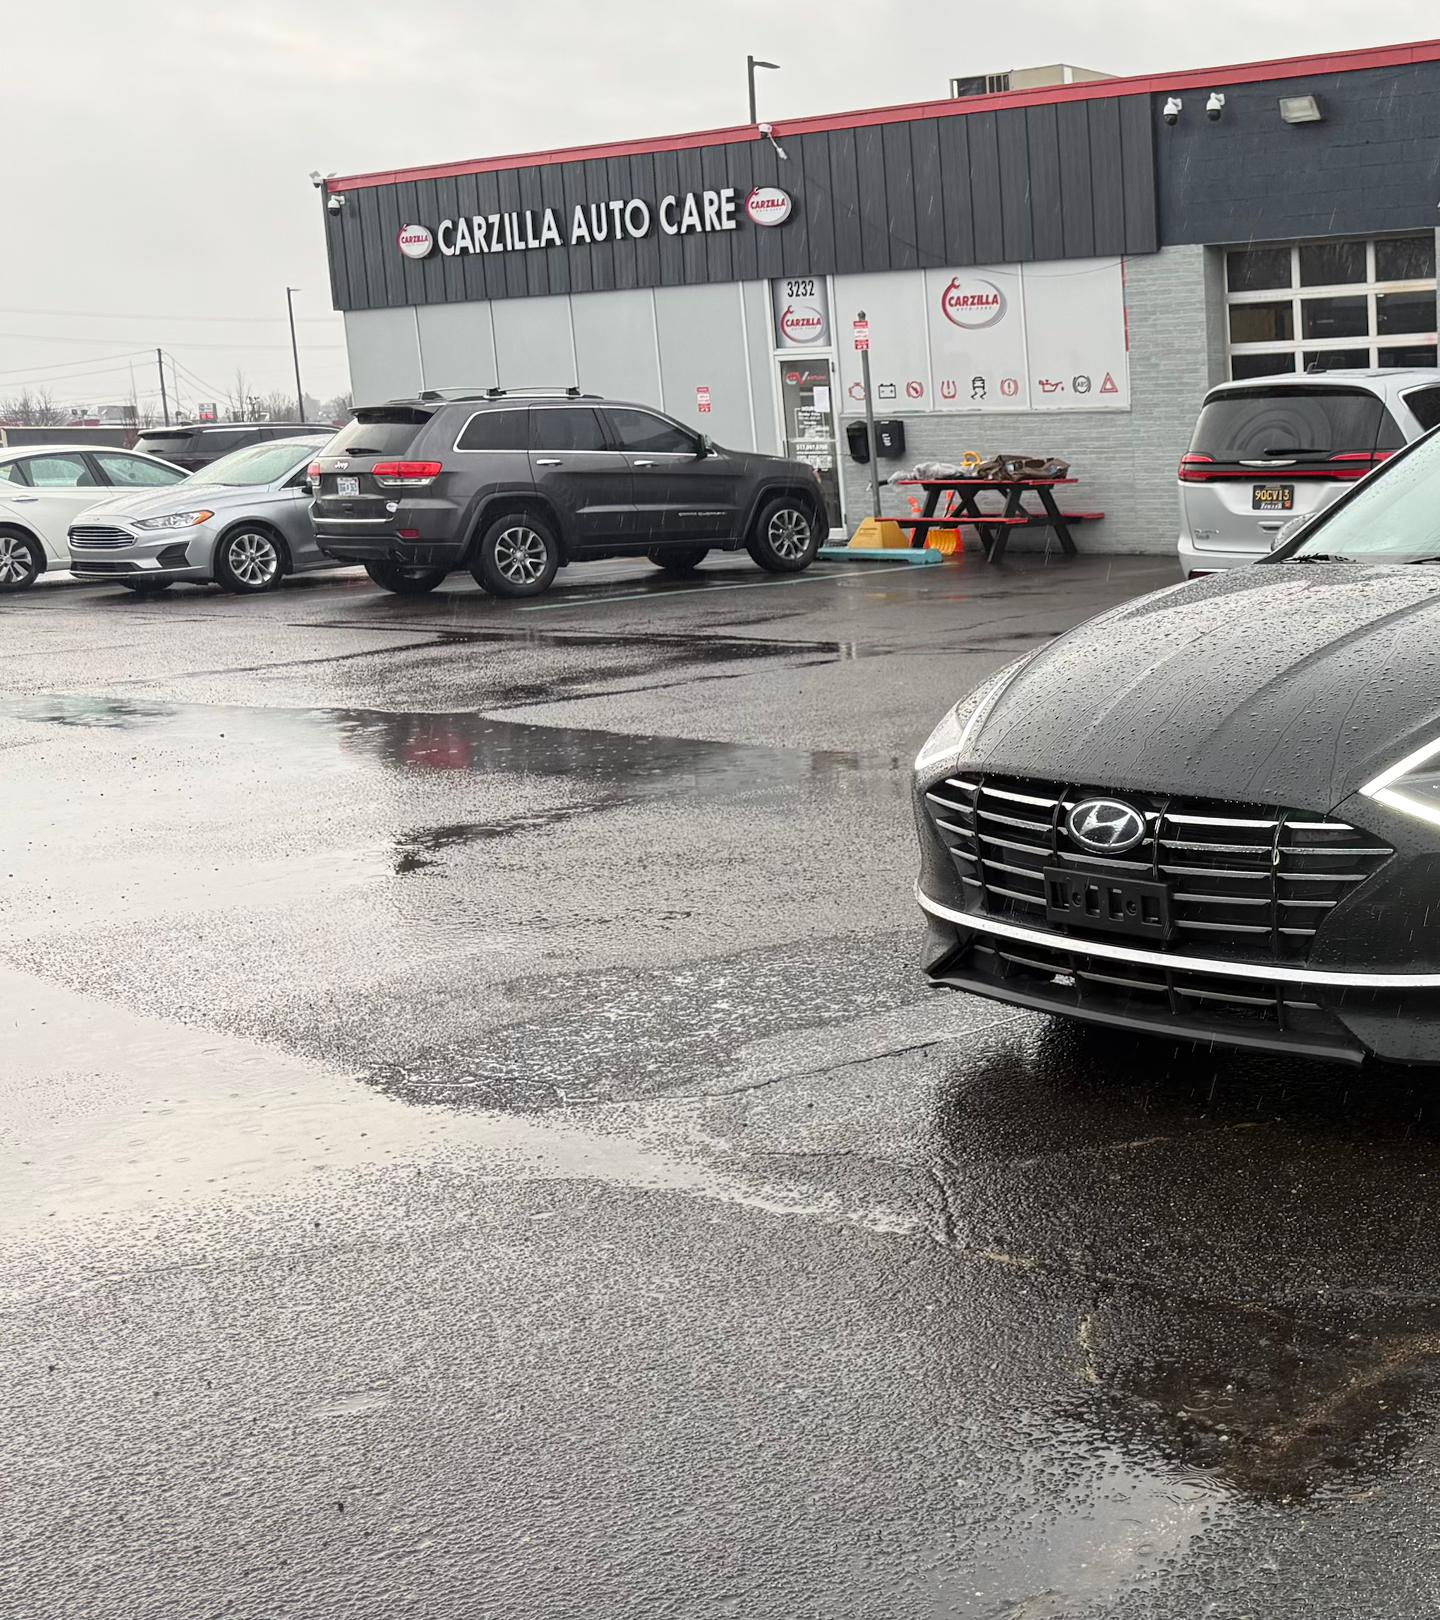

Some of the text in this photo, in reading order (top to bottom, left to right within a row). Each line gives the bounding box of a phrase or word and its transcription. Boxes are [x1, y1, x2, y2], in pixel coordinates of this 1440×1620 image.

[750, 198, 786, 210] CARZILLA
[437, 187, 737, 256] CARZILLA AUTO CARE
[401, 235, 428, 244] CARZILLA
[787, 280, 815, 297] 3232
[948, 293, 999, 308] CARZILLA
[785, 318, 822, 327] CARZILLA
